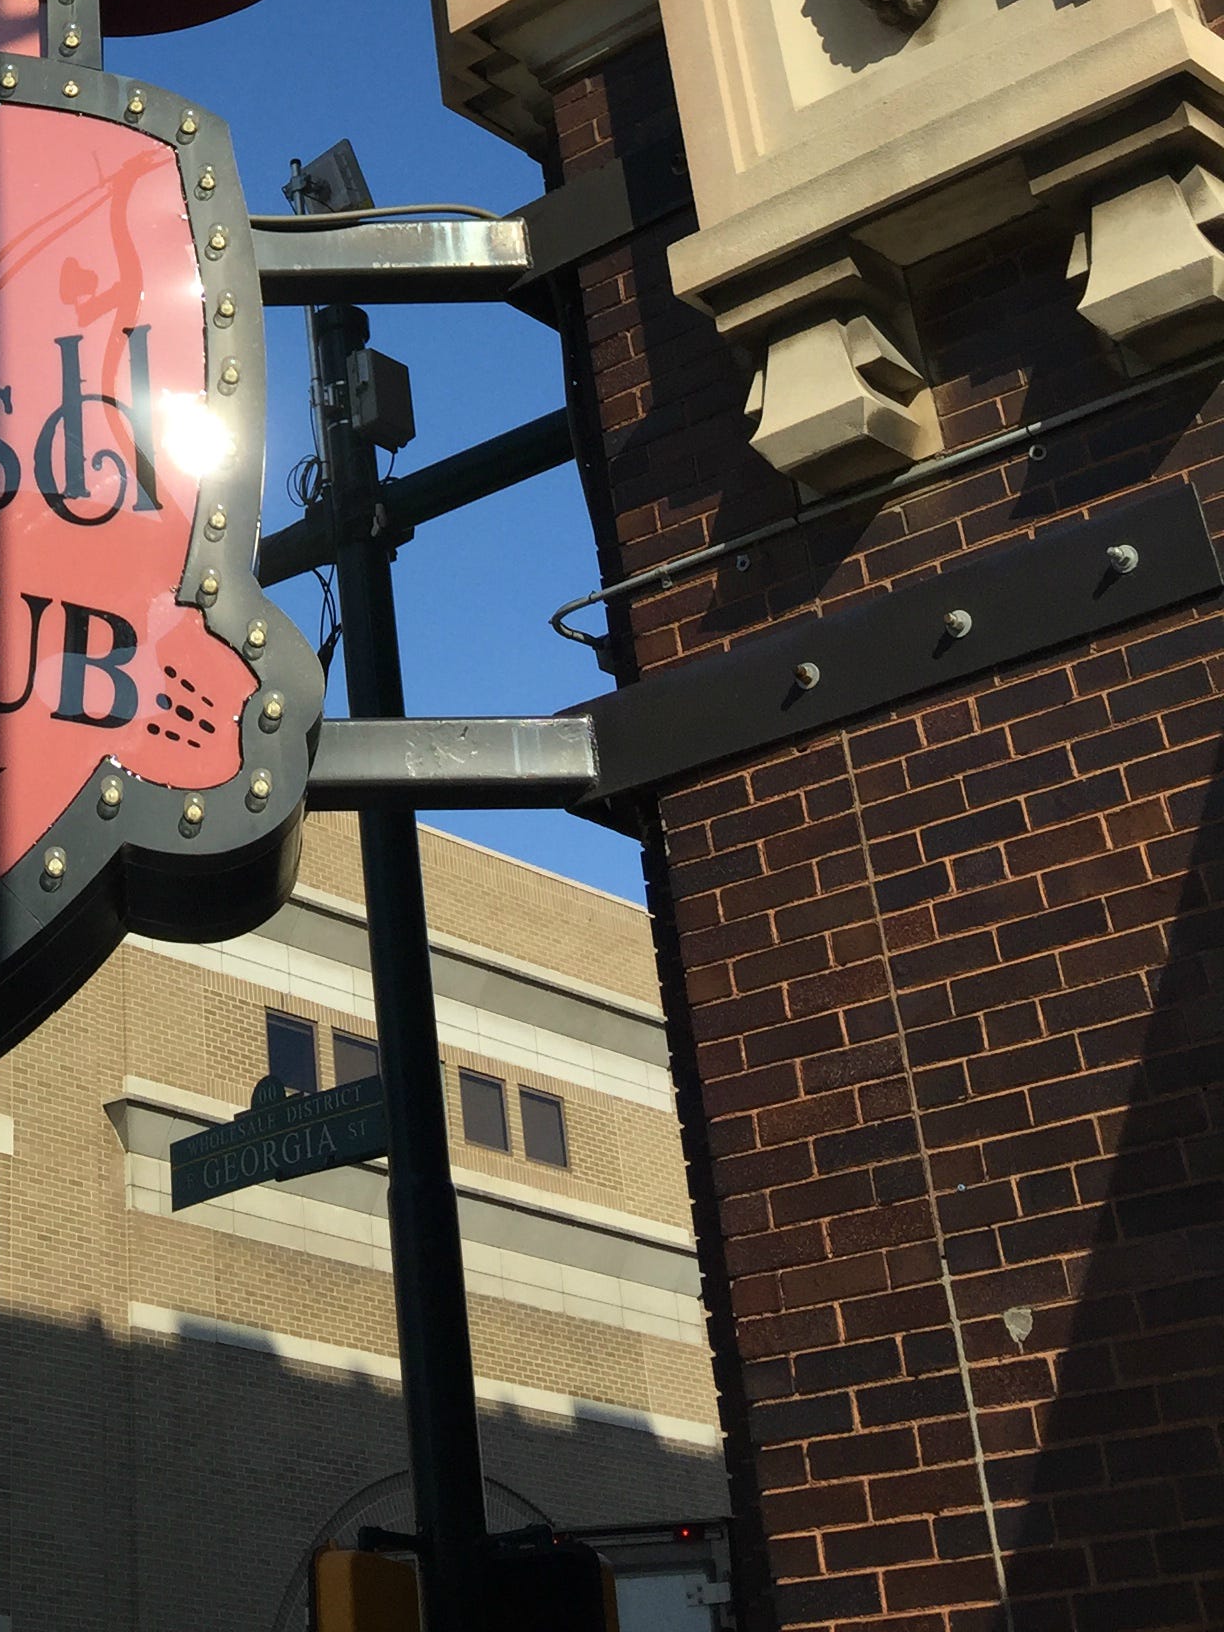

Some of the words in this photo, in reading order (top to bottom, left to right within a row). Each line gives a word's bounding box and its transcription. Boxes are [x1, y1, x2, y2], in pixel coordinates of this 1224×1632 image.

[187, 1113, 276, 1157] WHOLESALE
[286, 1084, 363, 1123] DISTRICT
[203, 1122, 337, 1190] GEORGIA
[347, 1119, 368, 1139] ST
